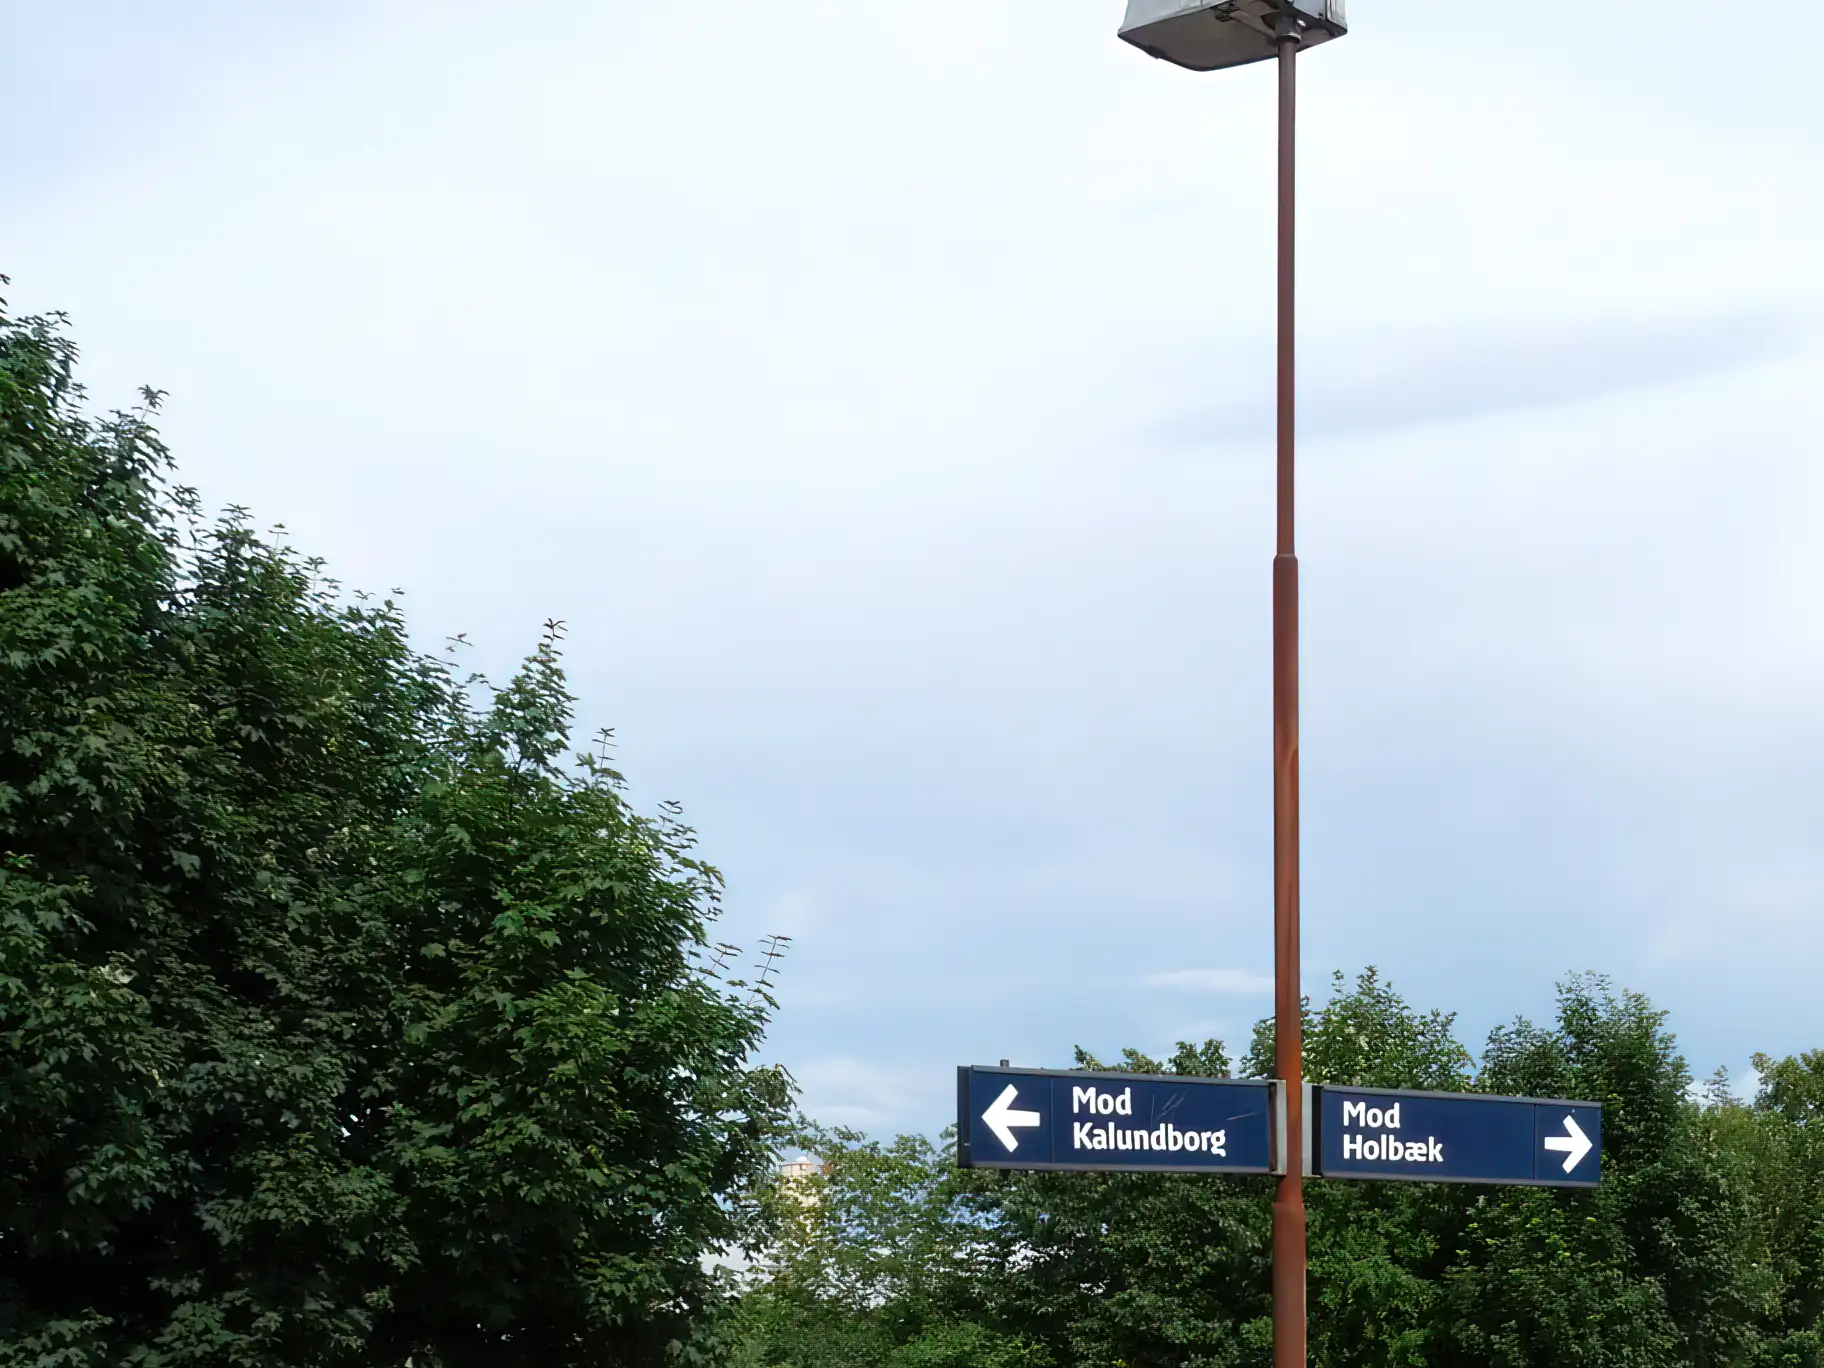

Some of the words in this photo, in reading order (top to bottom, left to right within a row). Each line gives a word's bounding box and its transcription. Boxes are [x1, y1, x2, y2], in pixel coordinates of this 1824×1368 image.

[1072, 1085, 1133, 1116] Mod
[1343, 1100, 1401, 1129] Mod
[1073, 1121, 1228, 1158] Kalundborg
[1343, 1133, 1444, 1162] Holbæk
